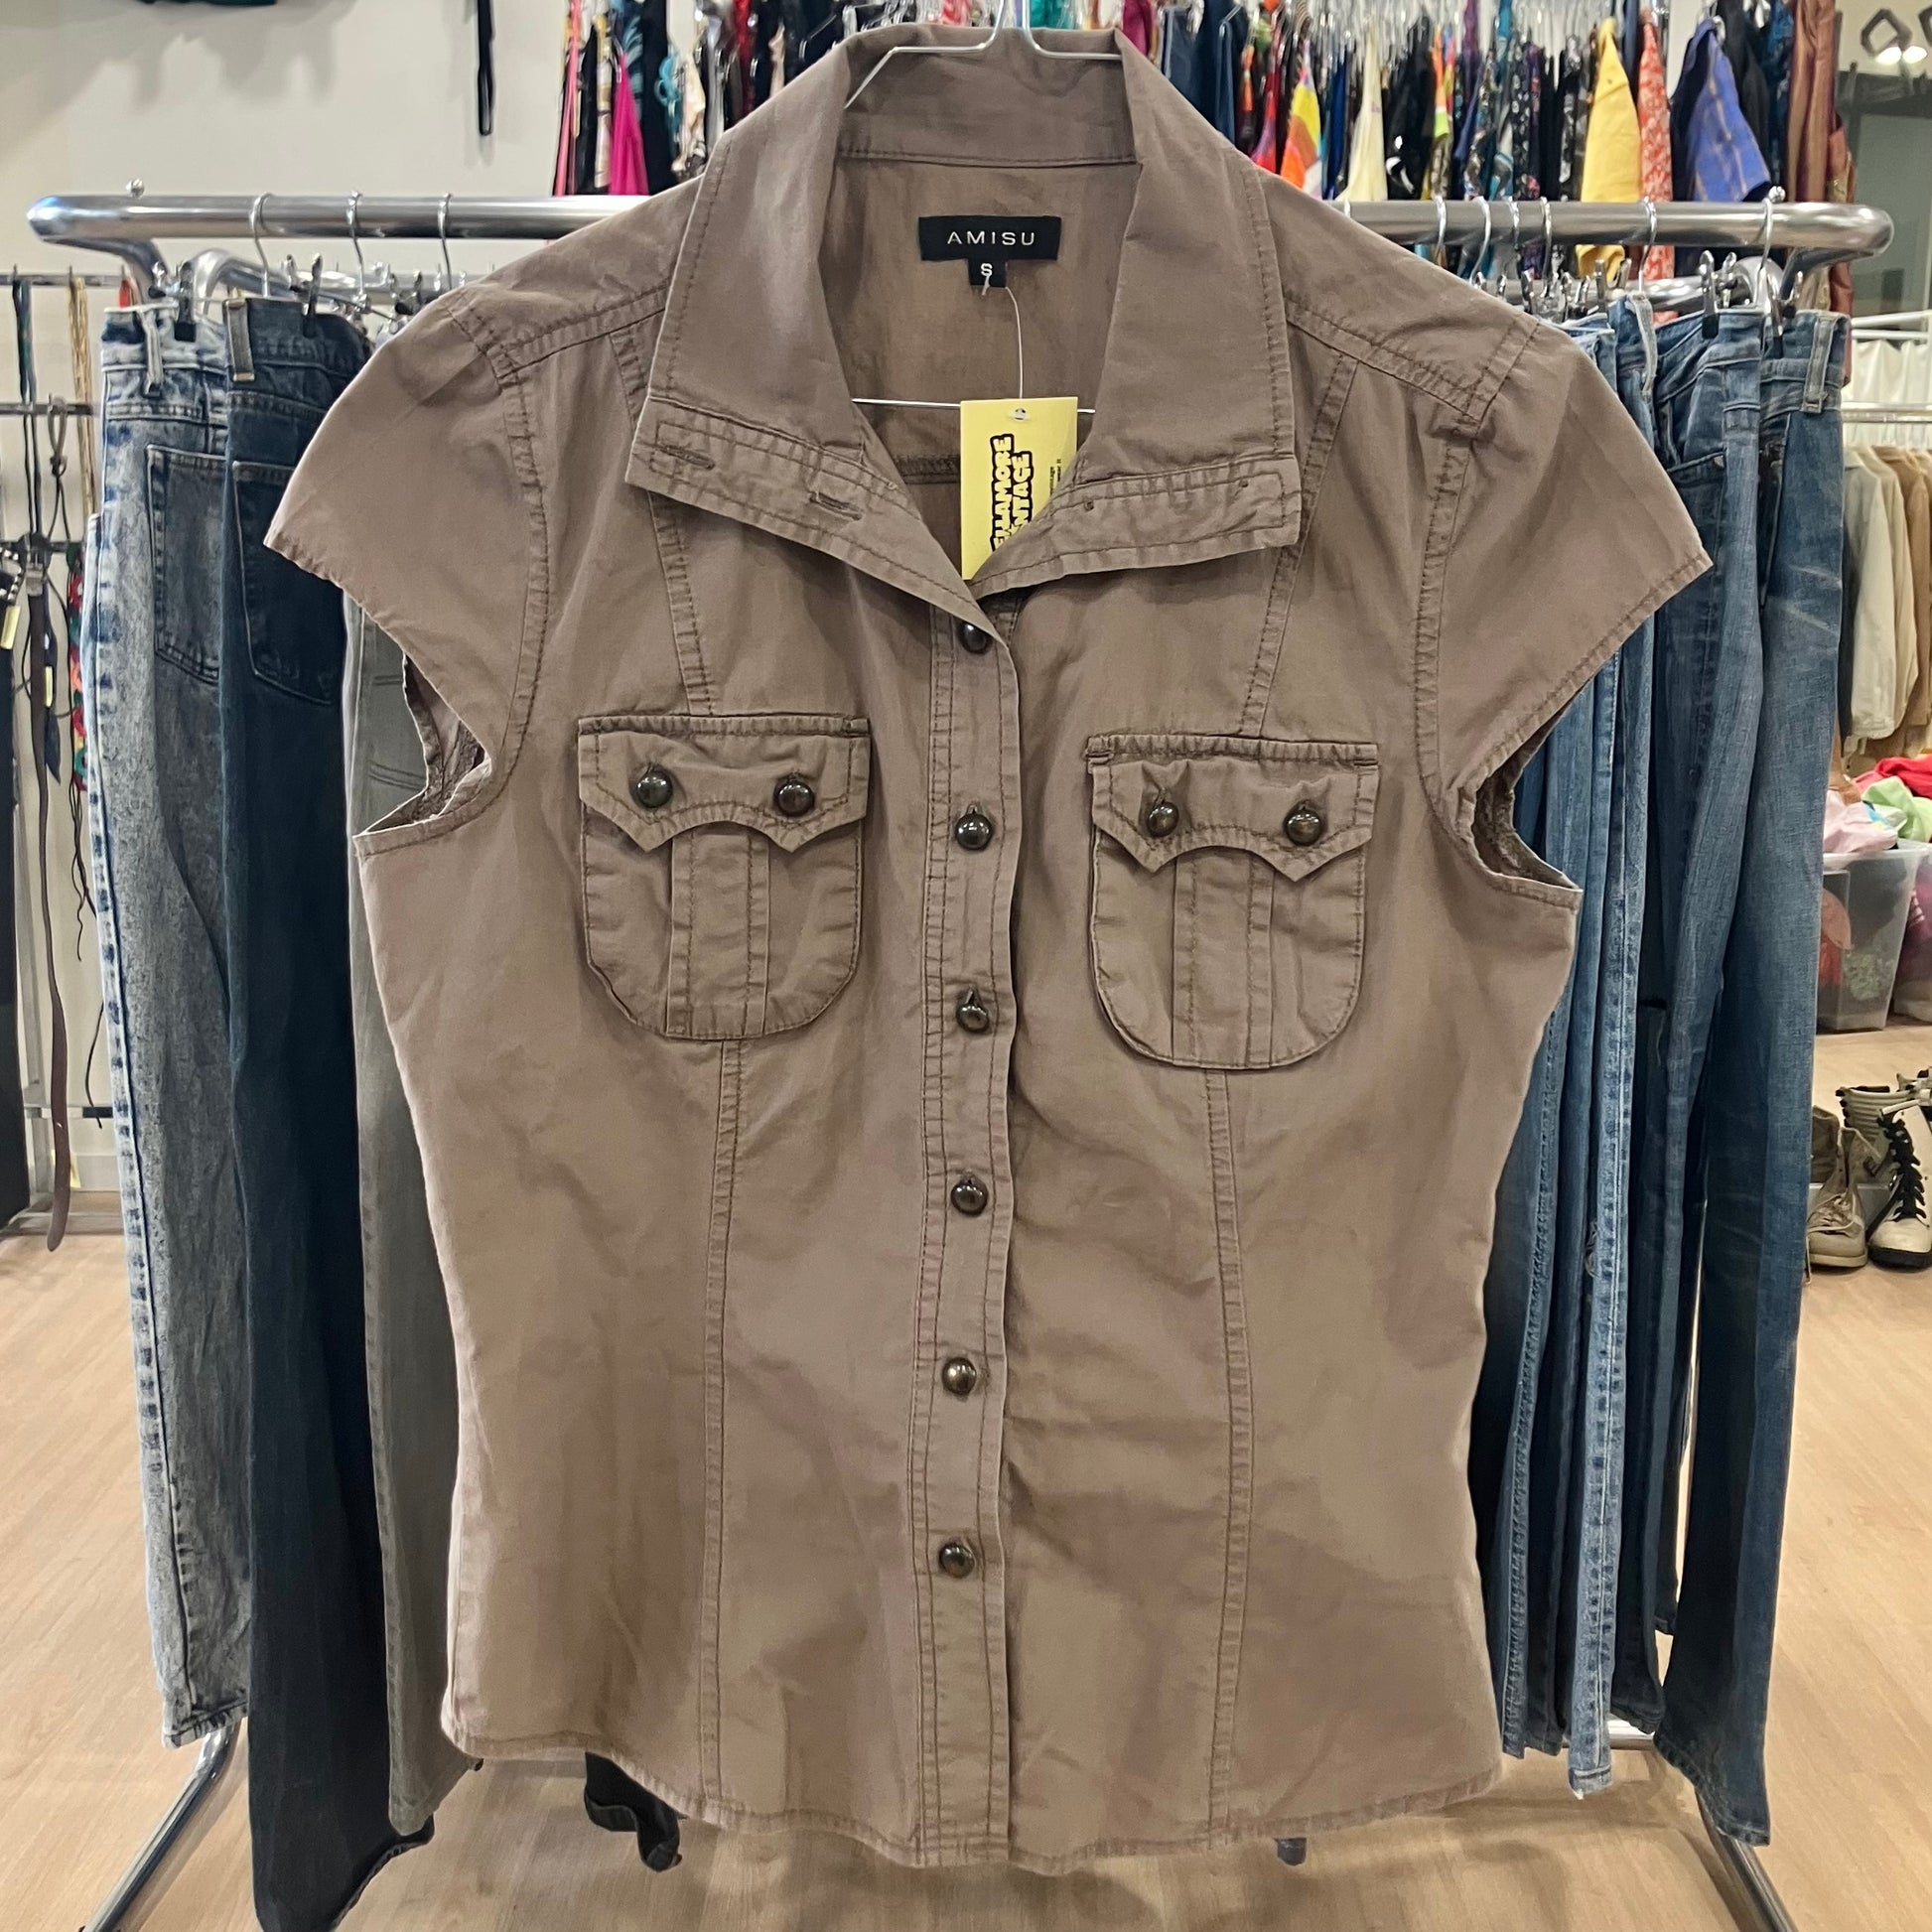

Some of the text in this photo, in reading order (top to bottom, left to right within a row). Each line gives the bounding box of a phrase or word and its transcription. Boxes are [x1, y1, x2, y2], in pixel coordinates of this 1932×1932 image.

[946, 230, 1035, 246] AMISU
[980, 262, 993, 277] S
[991, 435, 1013, 551] ELLAMORE
[1012, 452, 1032, 530] NTAGE
